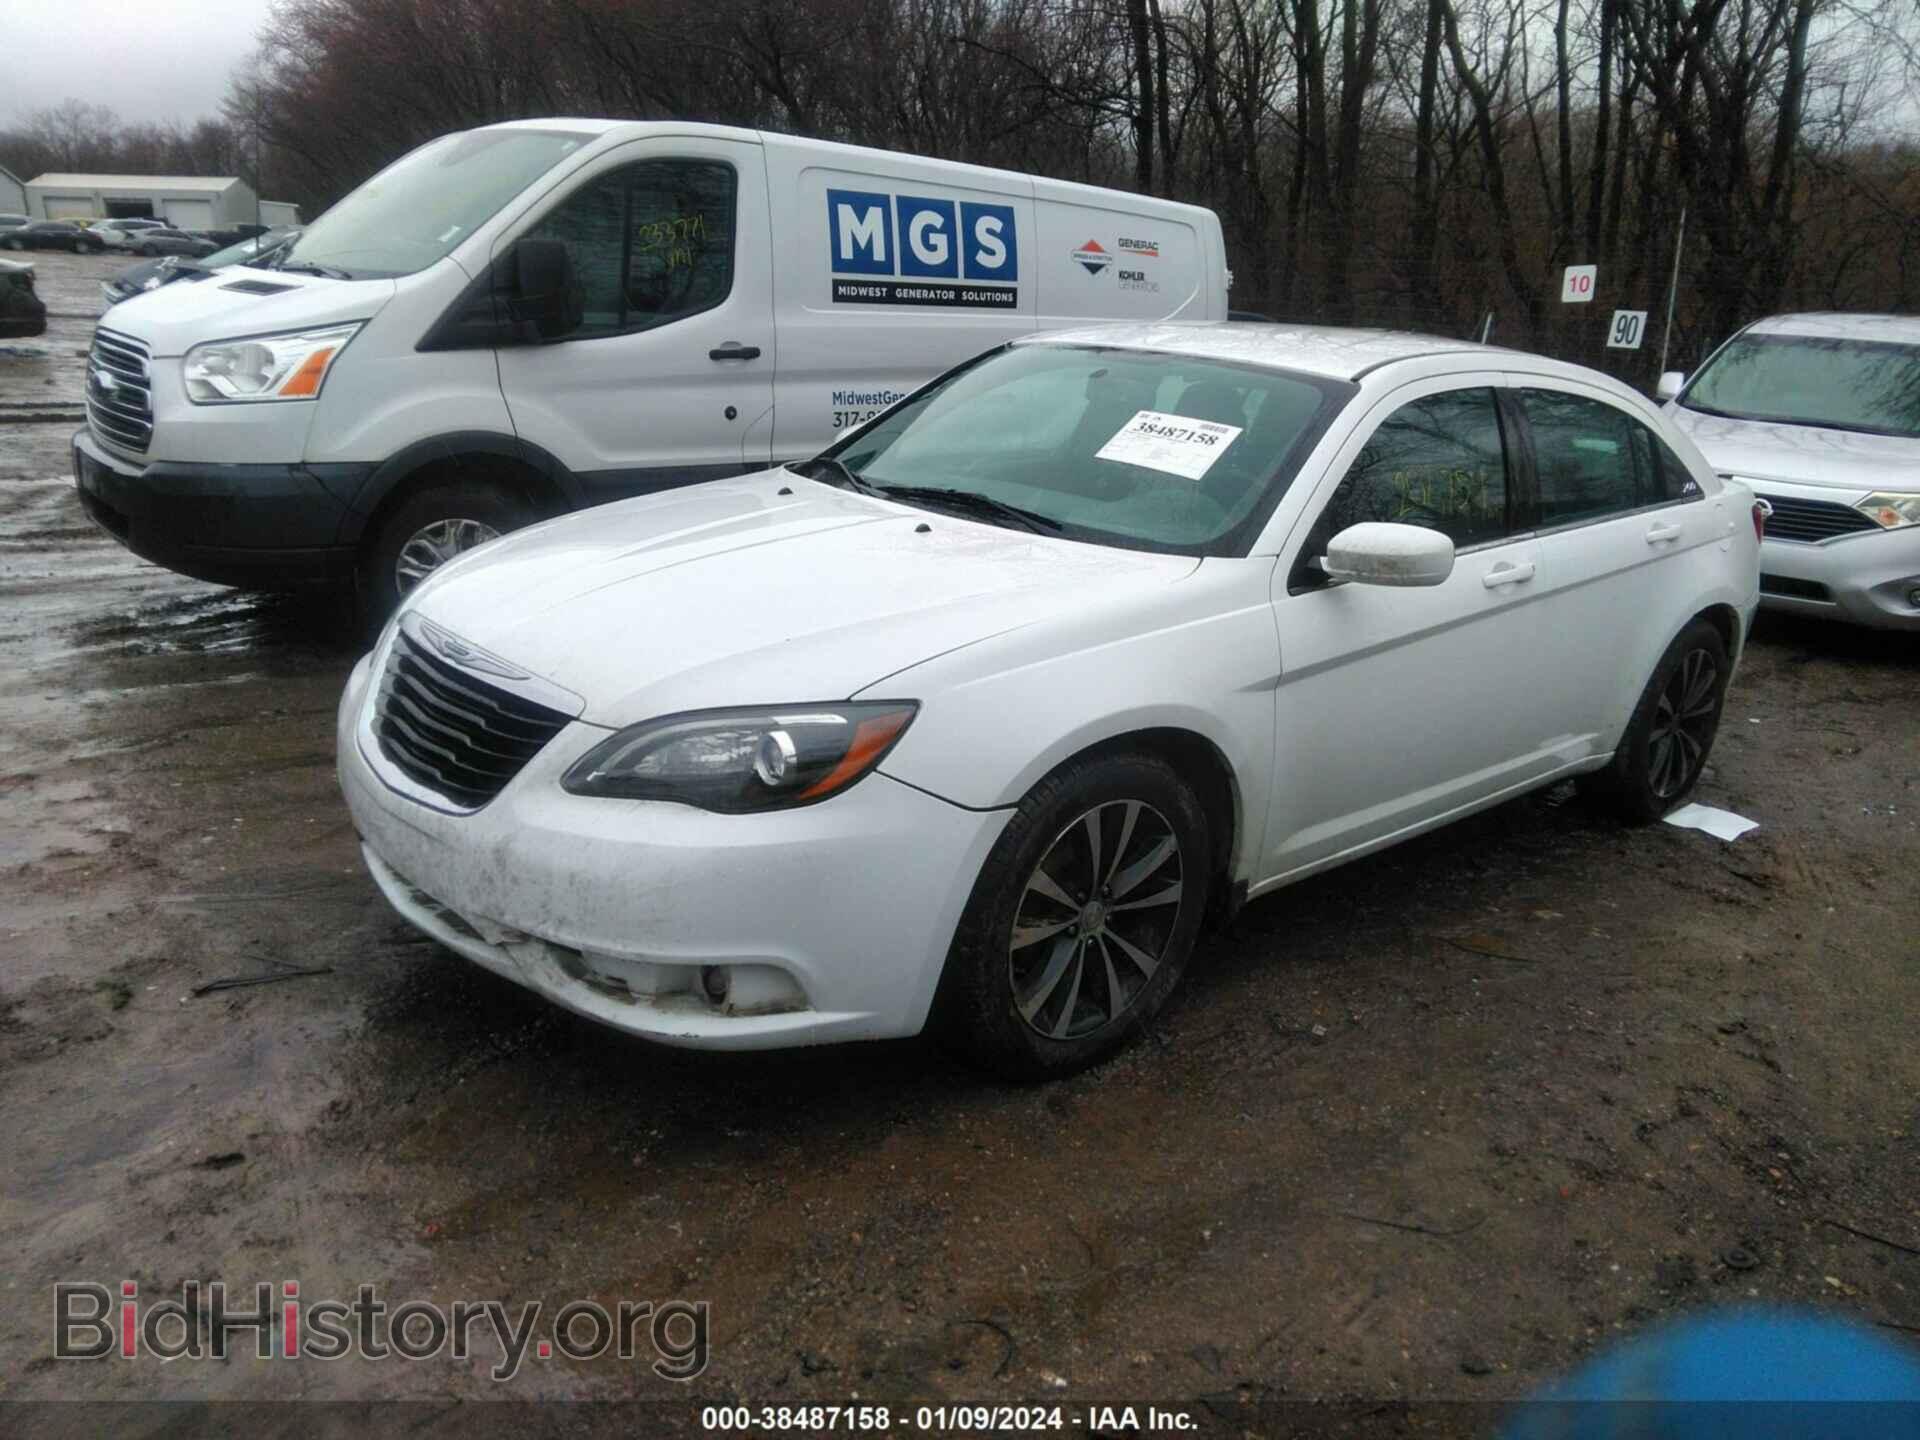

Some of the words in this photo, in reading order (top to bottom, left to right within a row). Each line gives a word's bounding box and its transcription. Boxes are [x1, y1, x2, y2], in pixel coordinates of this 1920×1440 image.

[837, 203, 1007, 269] MGS
[1118, 238, 1159, 250] GENERAC
[1119, 270, 1145, 281] KOHLER
[1570, 275, 1590, 293] 10
[838, 285, 887, 298] MIDWEST
[895, 287, 955, 301] GENERATOR
[961, 290, 1014, 303] SOLUTIONS
[1614, 314, 1639, 345] 90
[1133, 422, 1219, 446] 38487158
